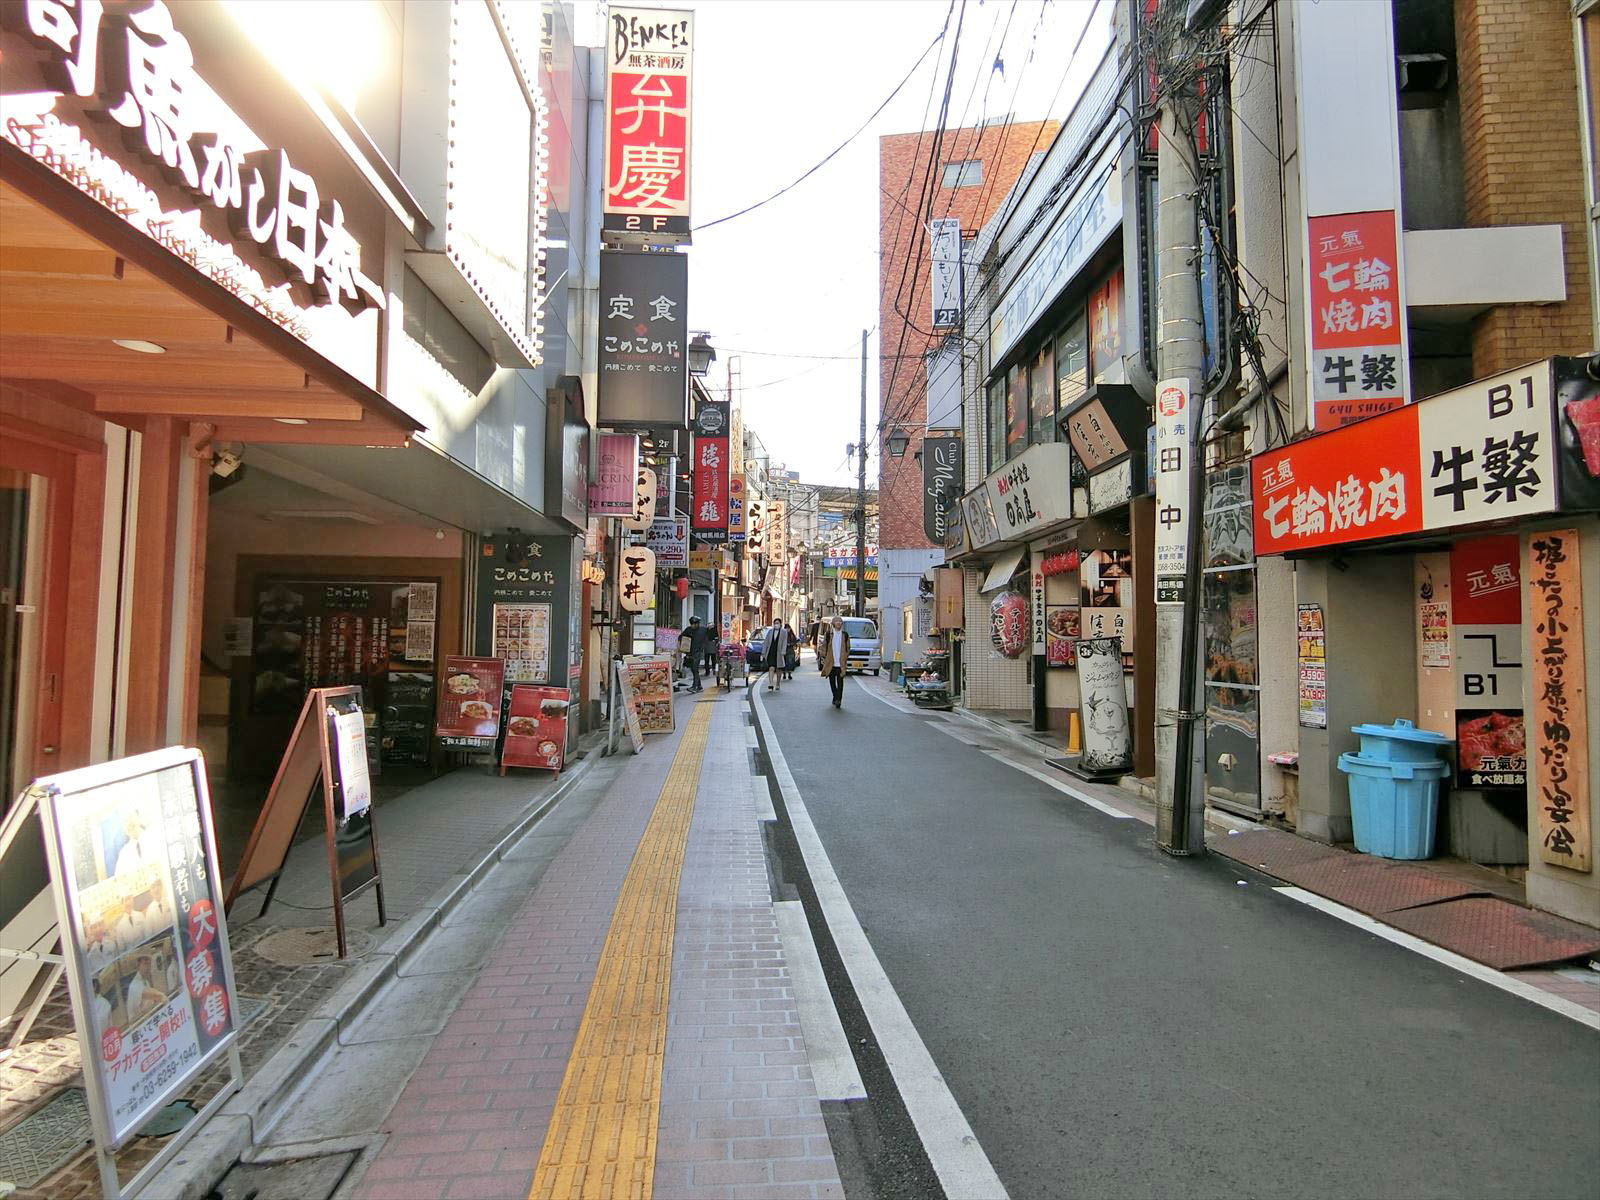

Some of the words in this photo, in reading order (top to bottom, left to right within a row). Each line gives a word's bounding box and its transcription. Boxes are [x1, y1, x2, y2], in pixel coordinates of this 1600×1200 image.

[628, 53, 685, 70] 無茶酒房
[609, 74, 688, 209] 弁慶
[625, 215, 667, 231] 2F
[1320, 230, 1362, 253] 元氣
[1319, 256, 1392, 293] 七輪
[607, 294, 677, 322] 定食
[938, 310, 955, 323] 2F
[604, 336, 679, 355] こめこめや
[1323, 353, 1397, 394] 牛繁
[1488, 376, 1534, 420] B1
[1158, 423, 1186, 439] 小売
[948, 442, 957, 464] Club
[1262, 457, 1294, 491] 元氣
[1431, 430, 1542, 512] 牛繁
[927, 446, 954, 538] Magcian
[1160, 446, 1182, 530] 田中
[730, 497, 742, 526] 松屋
[749, 503, 764, 549] らーめん
[494, 568, 553, 582] こめこめや
[623, 556, 647, 605] 天丼
[1466, 563, 1516, 592] 元氣
[1161, 590, 1179, 599] 3-2
[1464, 674, 1497, 695] B1
[188, 906, 226, 1034] 大募集
